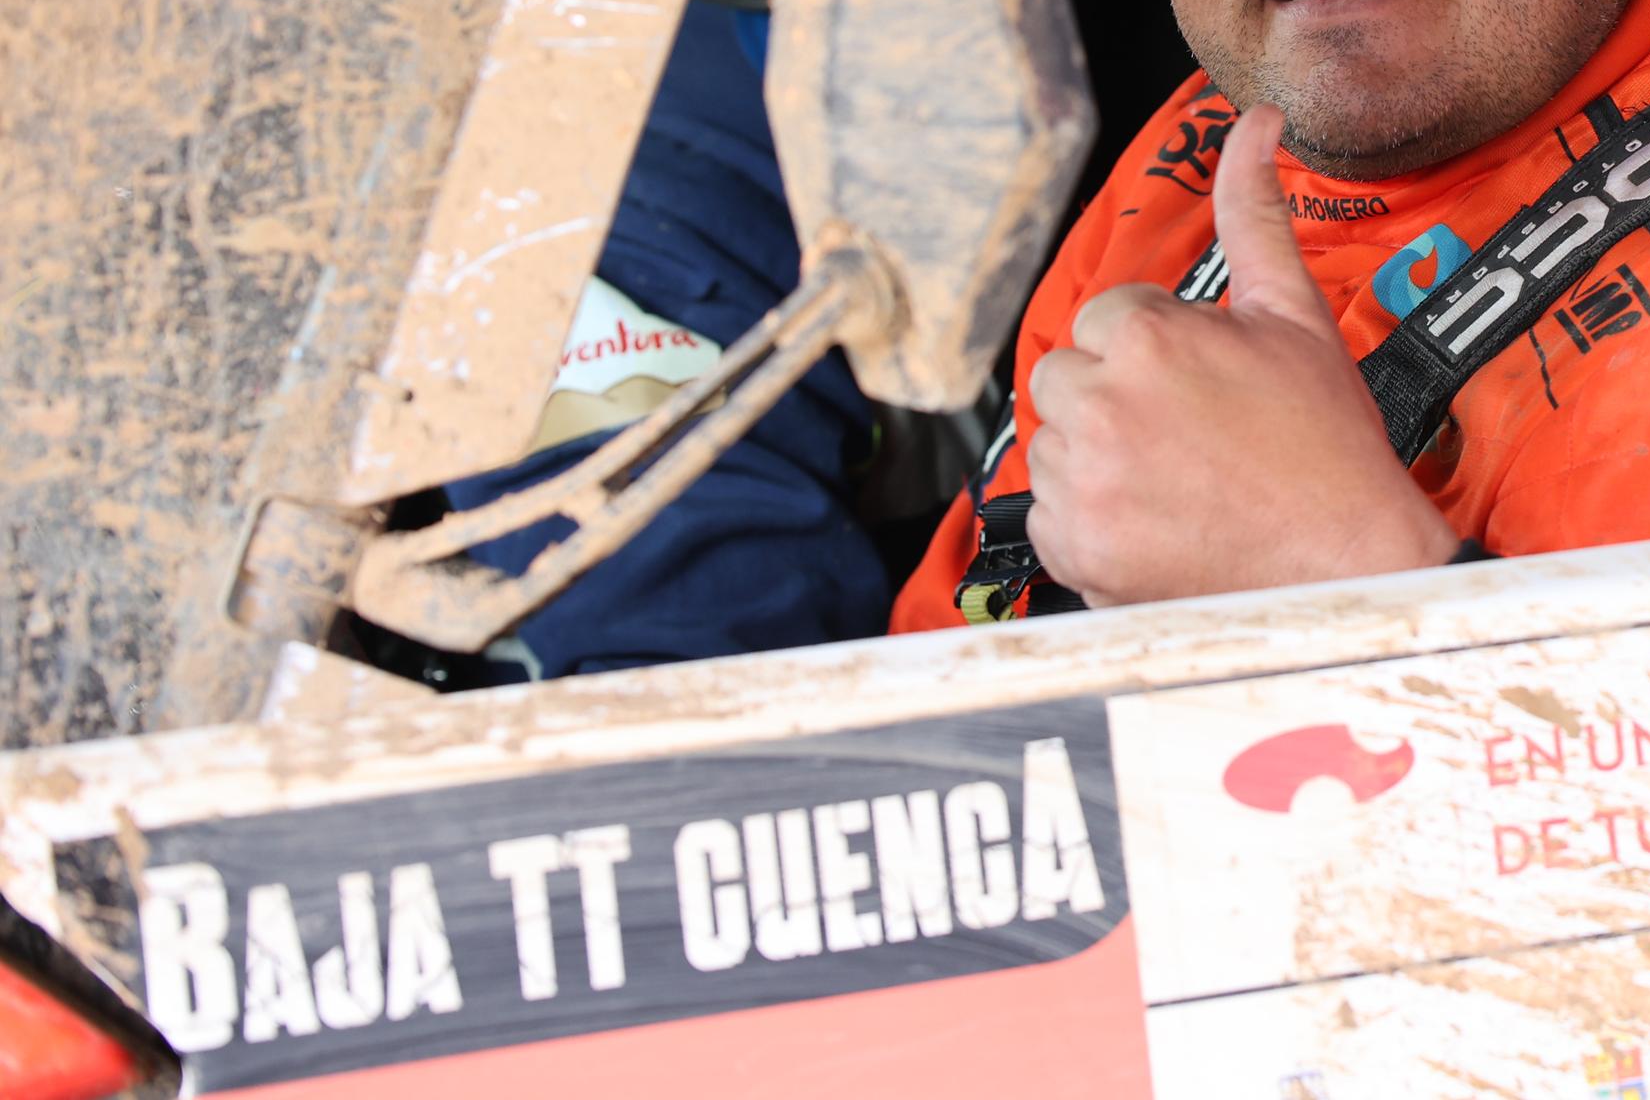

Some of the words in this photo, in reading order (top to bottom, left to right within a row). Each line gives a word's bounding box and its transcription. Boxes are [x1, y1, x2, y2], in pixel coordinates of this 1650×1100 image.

[554, 318, 698, 379] ventura
[1483, 722, 1565, 786] EN
[1494, 818, 1573, 876] DE
[138, 862, 464, 1052] BAJA
[487, 823, 632, 1002] TT
[674, 736, 1106, 972] CUENCA
